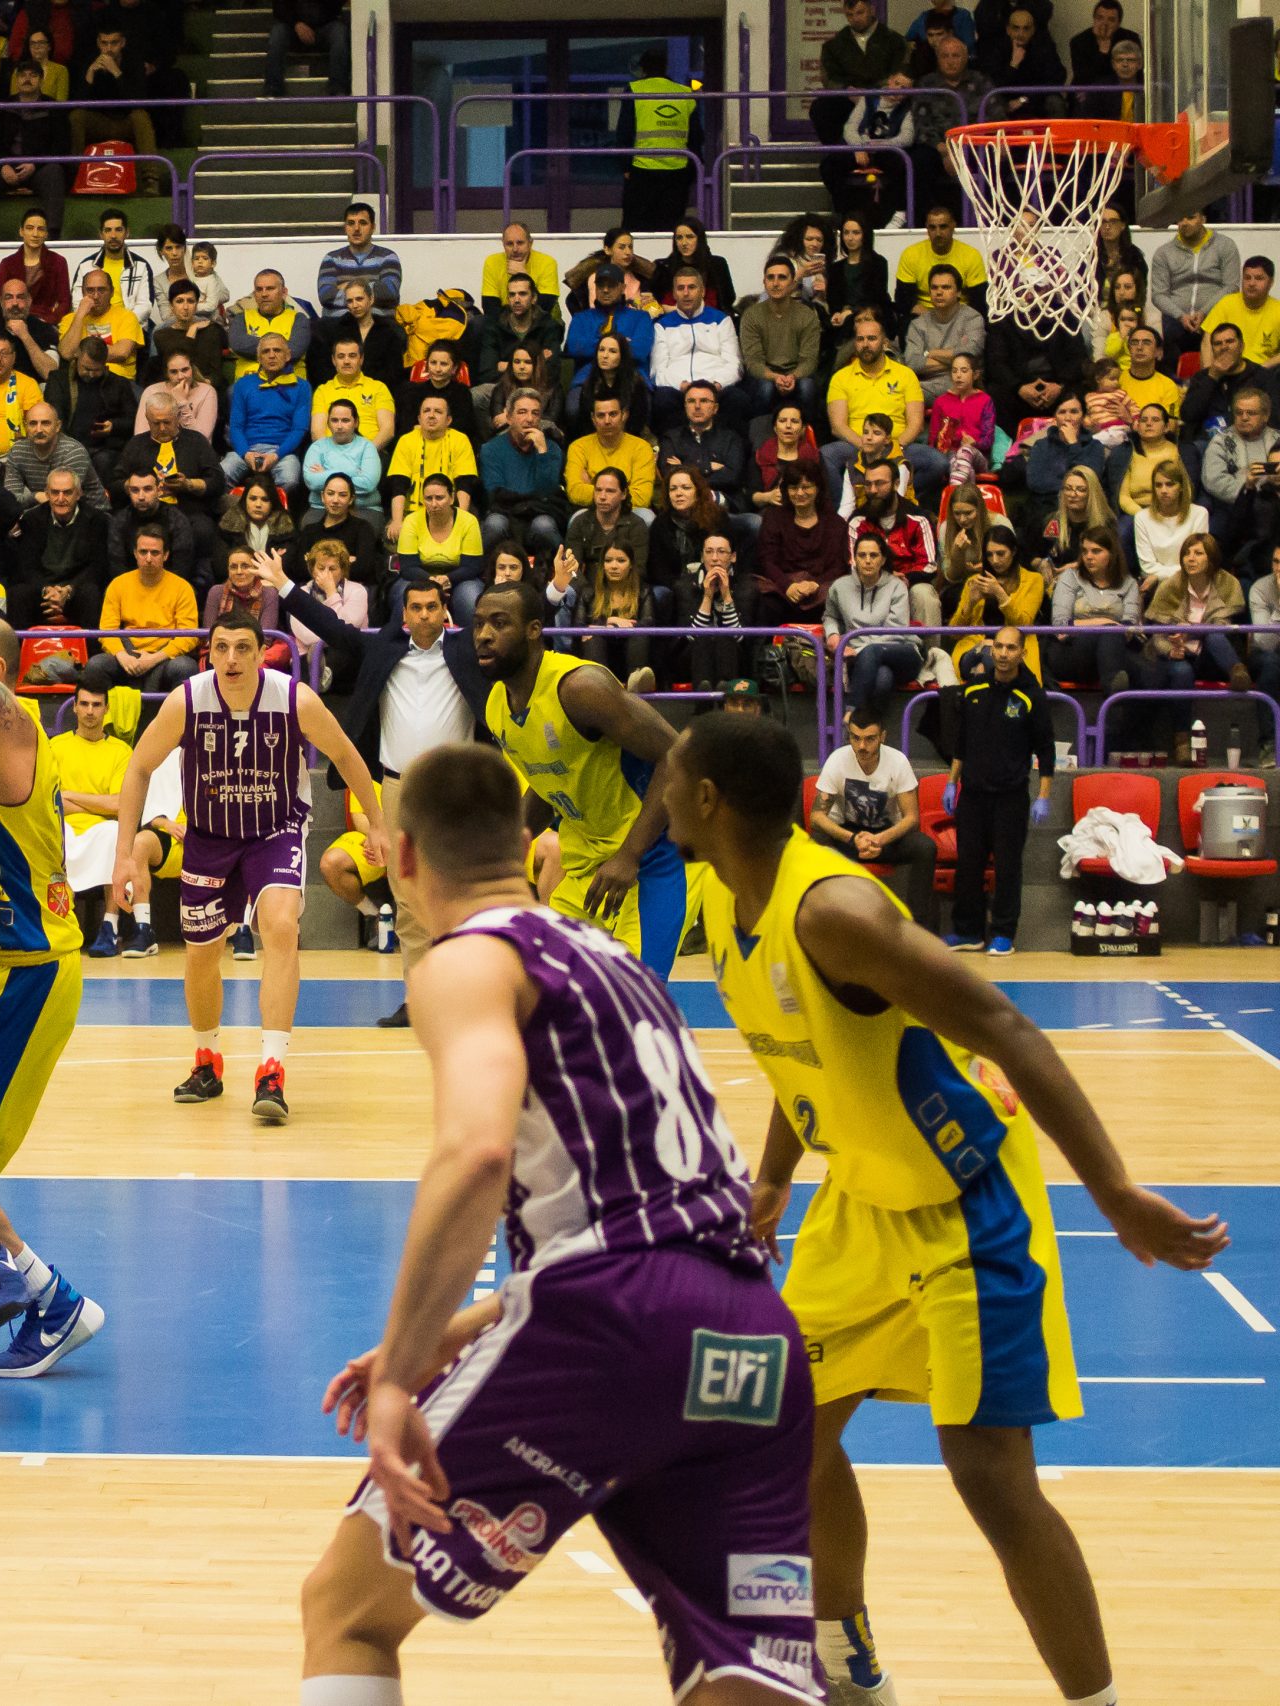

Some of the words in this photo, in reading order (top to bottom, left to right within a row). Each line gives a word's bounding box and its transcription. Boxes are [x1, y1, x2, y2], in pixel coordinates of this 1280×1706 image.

[233, 731, 248, 757] 7
[201, 769, 233, 781] BCMU
[290, 846, 301, 868] 7
